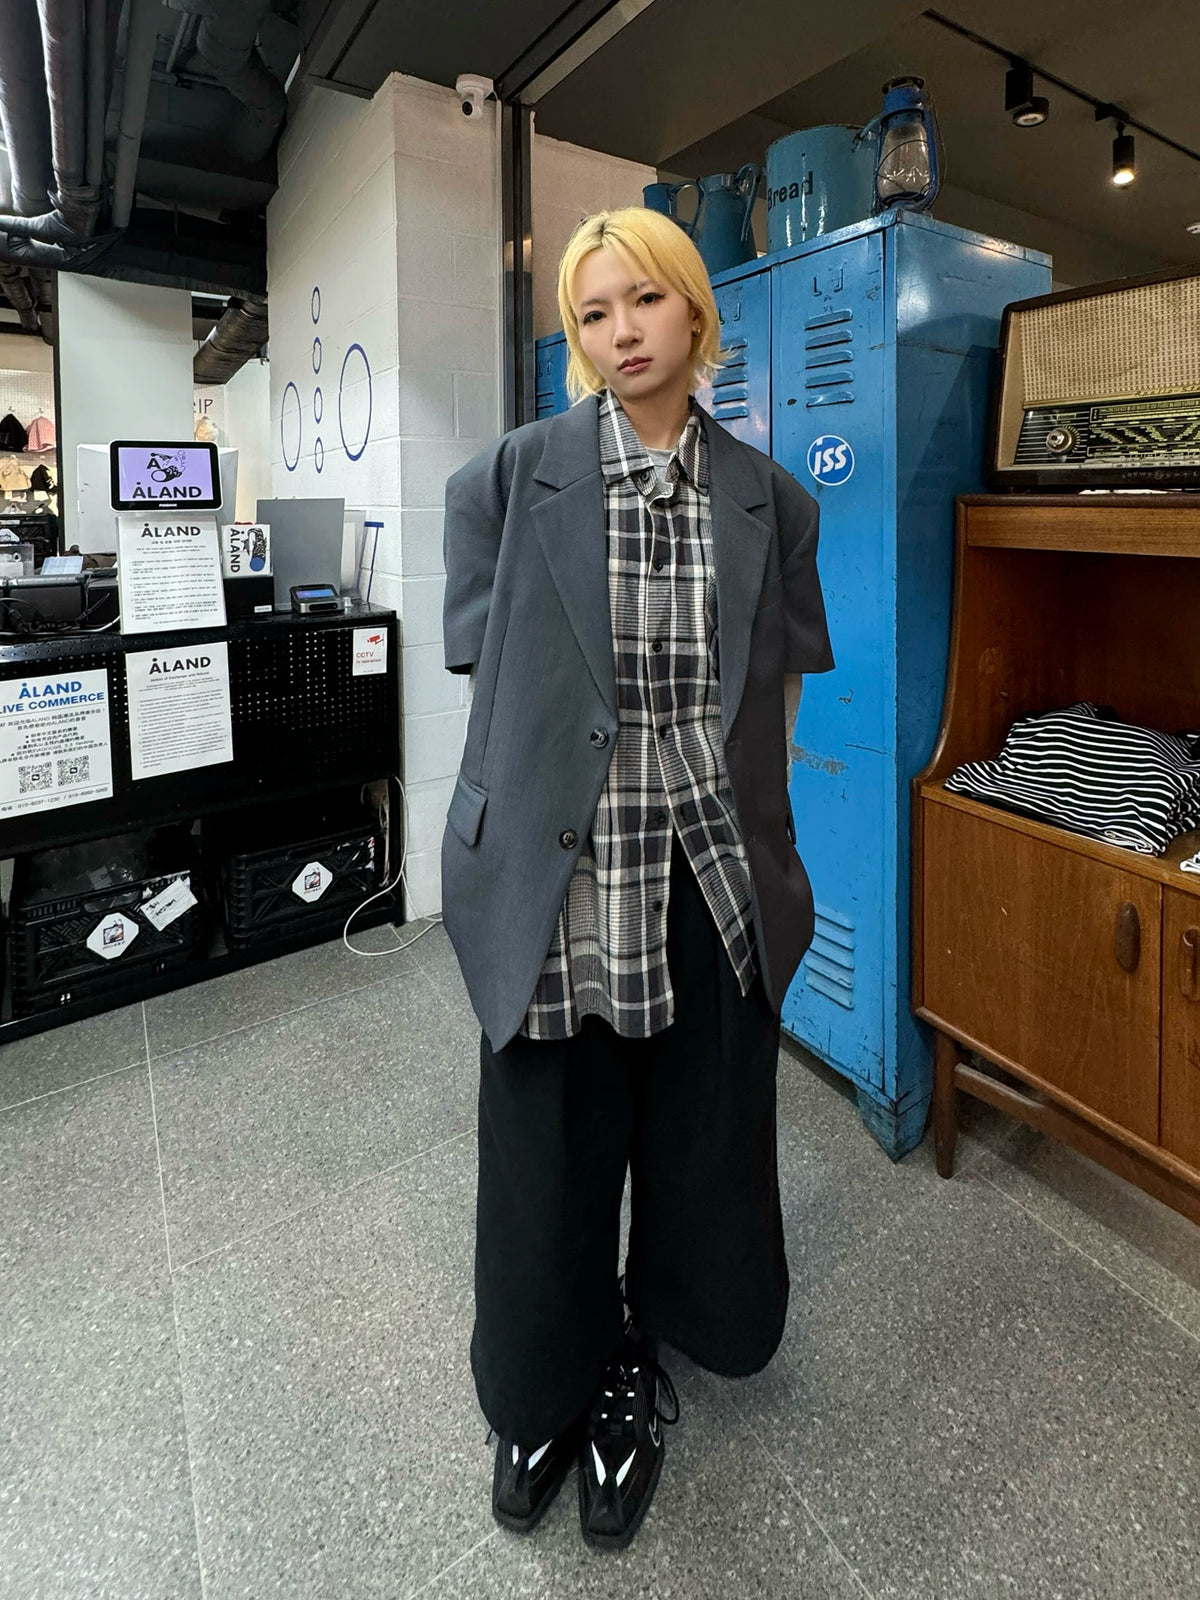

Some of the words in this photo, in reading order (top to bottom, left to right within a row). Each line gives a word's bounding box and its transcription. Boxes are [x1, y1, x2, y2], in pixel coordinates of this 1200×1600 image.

[768, 171, 813, 211] Bread
[193, 398, 213, 414] IP
[356, 651, 374, 659] CCTV
[28, 692, 105, 709] COMMERCE
